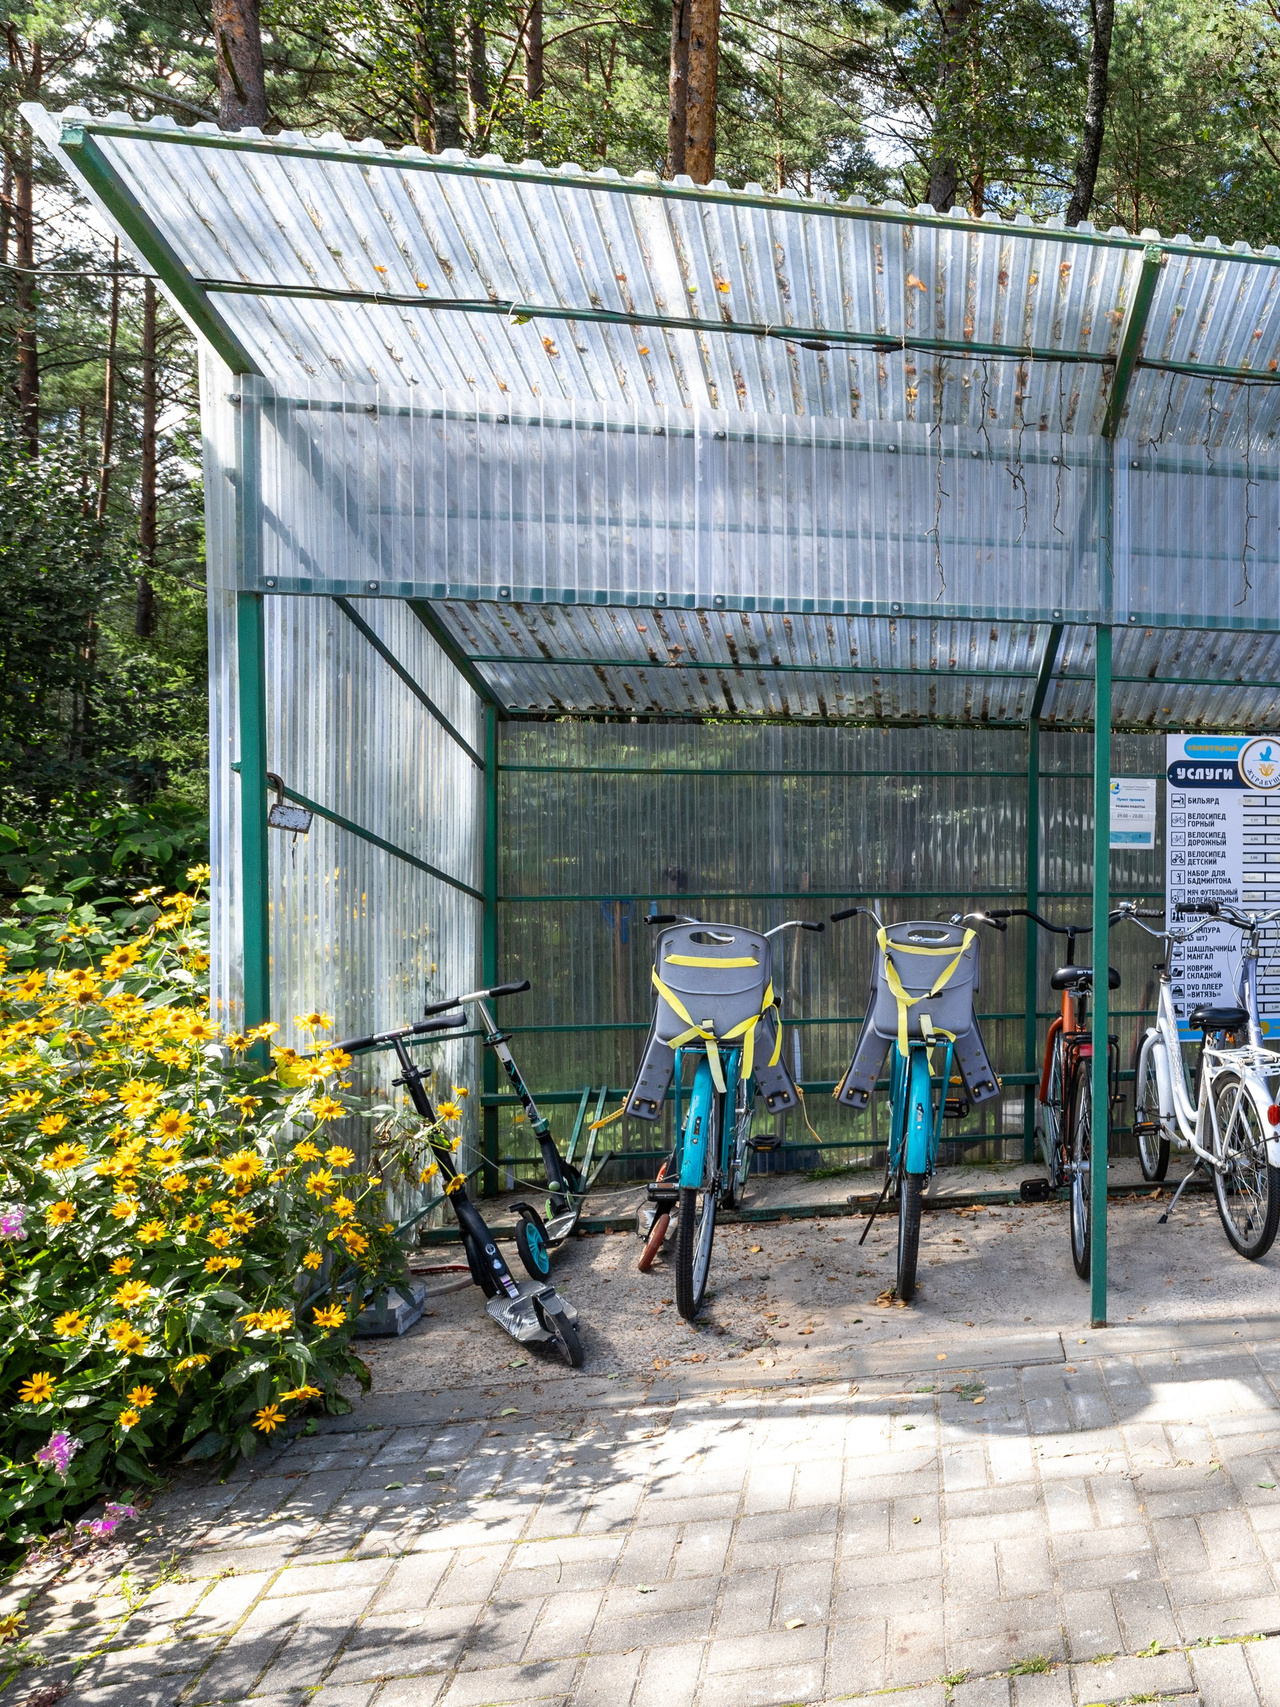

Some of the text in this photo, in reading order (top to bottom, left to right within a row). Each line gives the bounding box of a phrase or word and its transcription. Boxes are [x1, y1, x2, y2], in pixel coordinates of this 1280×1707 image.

[1187, 744, 1238, 753] санаторий
[1176, 768, 1234, 780] УСЛУГИ
[1188, 797, 1220, 806] БИЛЬЯРД
[1211, 870, 1226, 878] ДЛЯ
